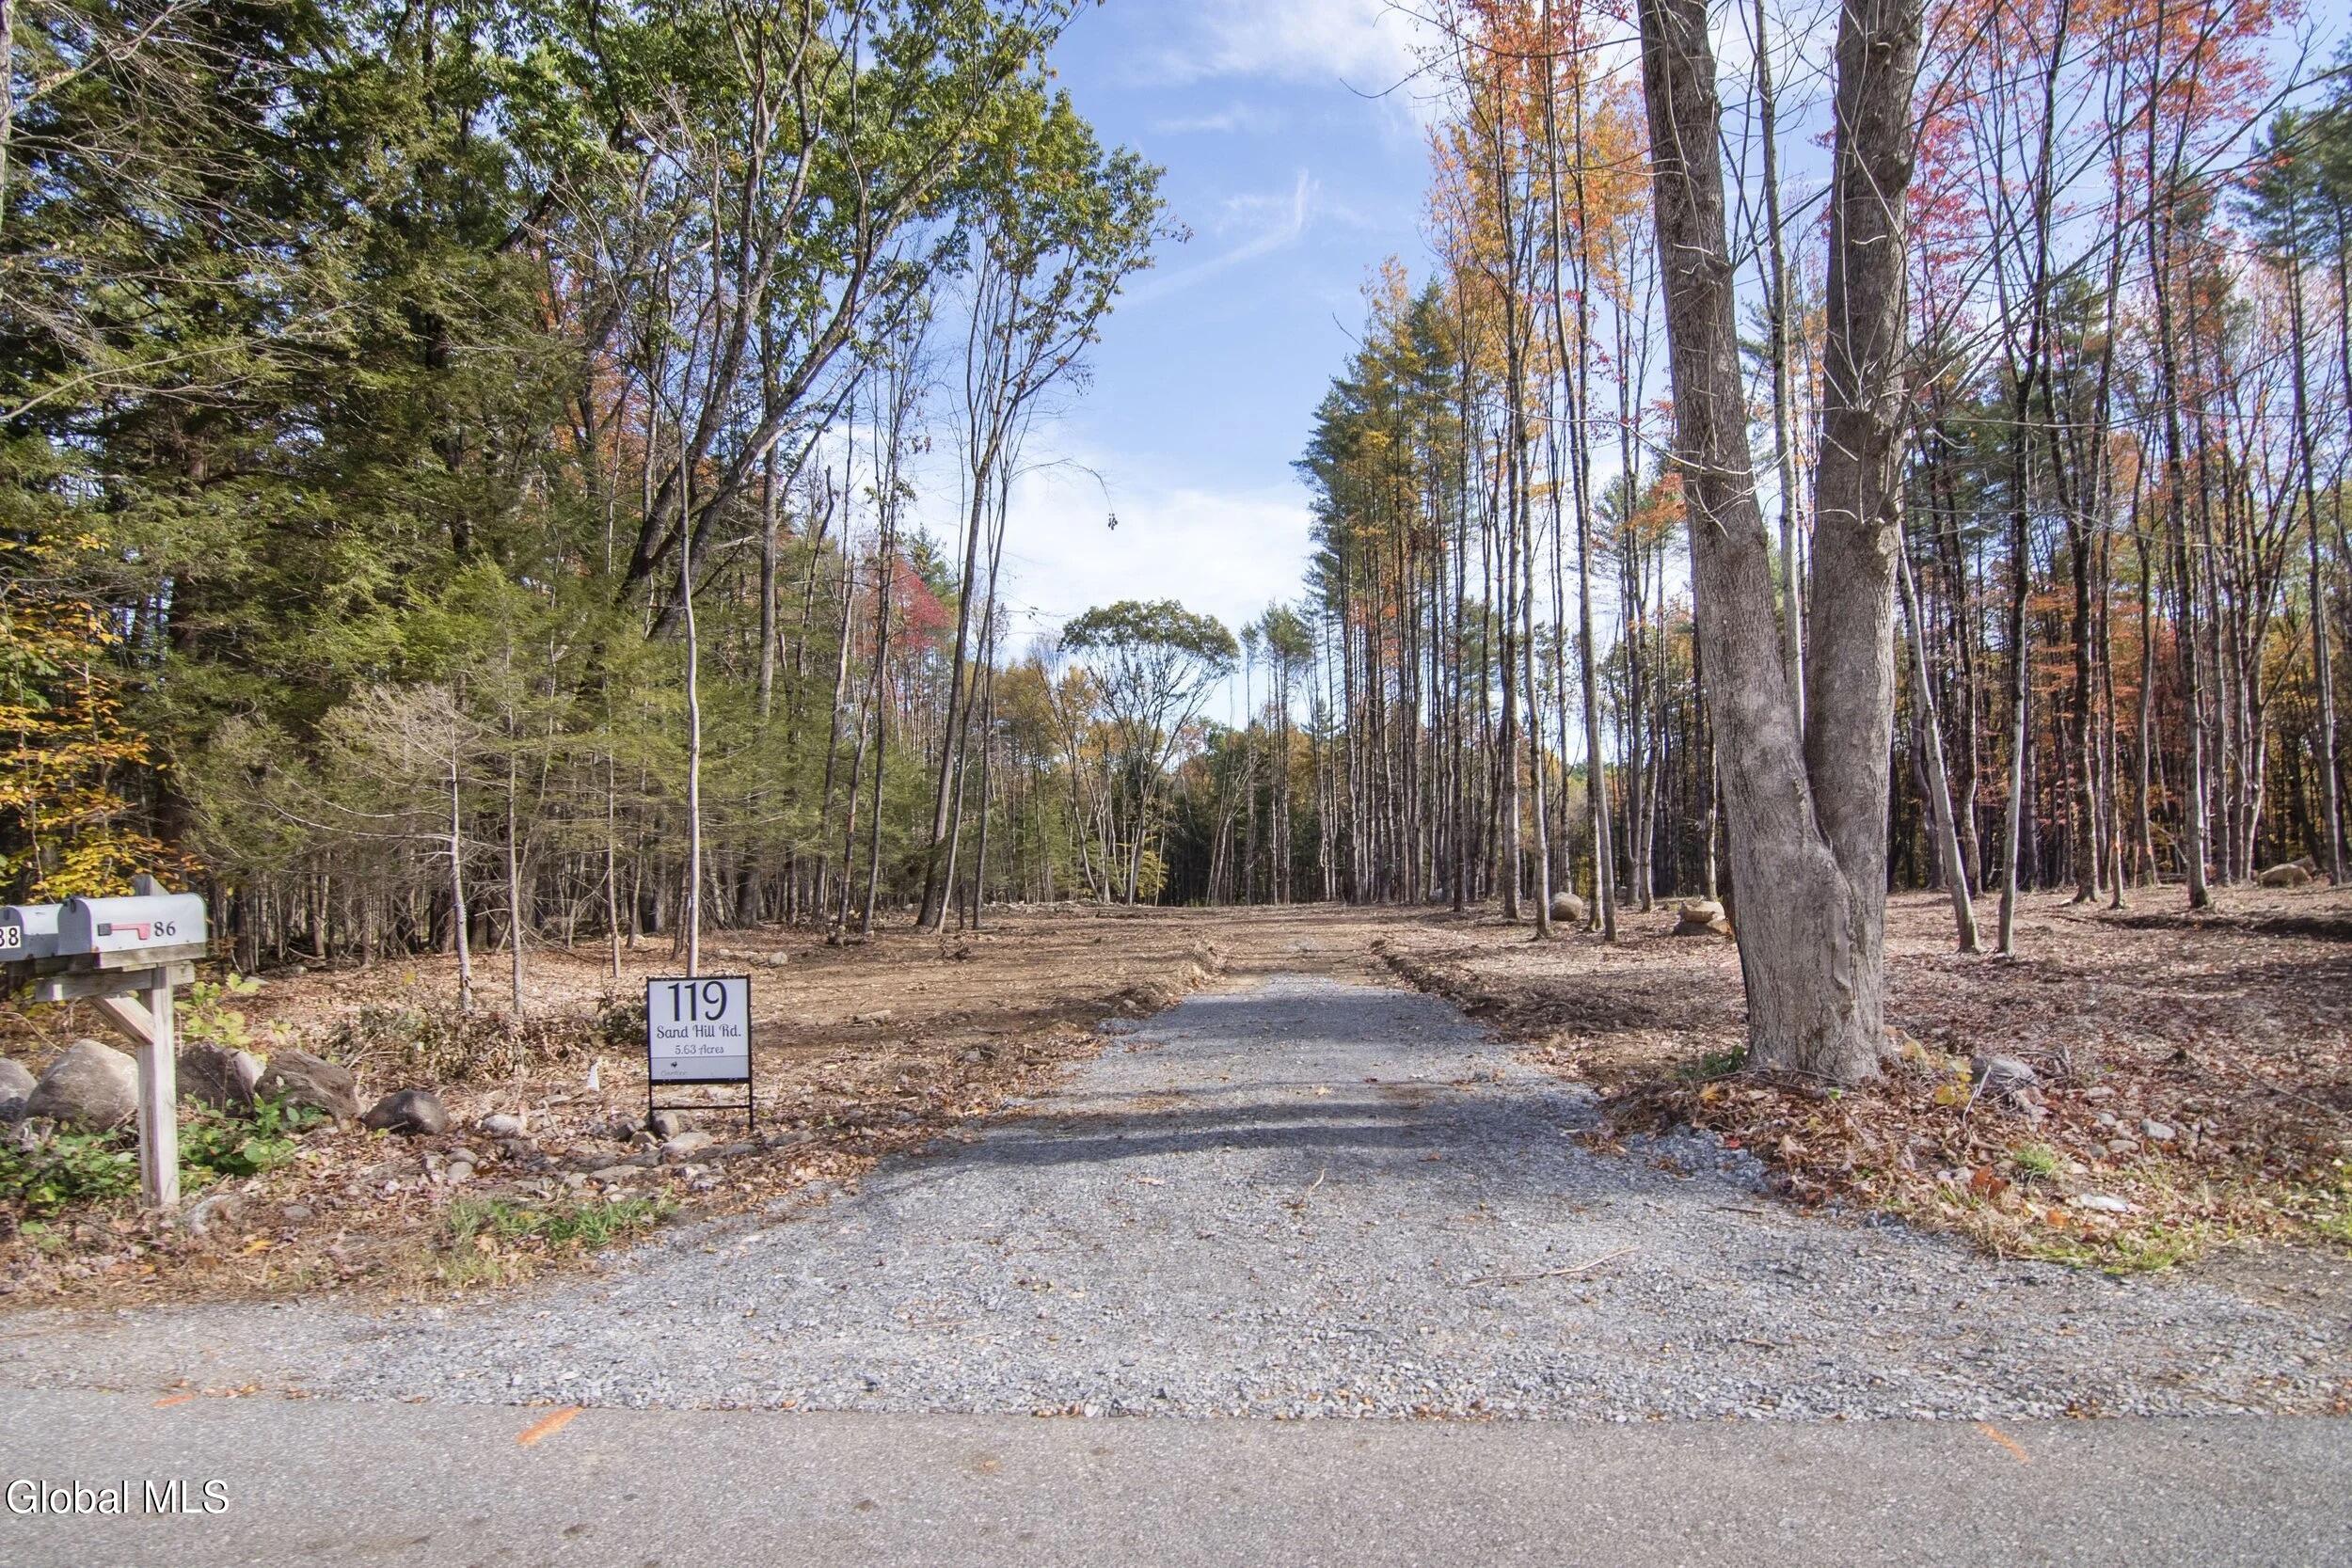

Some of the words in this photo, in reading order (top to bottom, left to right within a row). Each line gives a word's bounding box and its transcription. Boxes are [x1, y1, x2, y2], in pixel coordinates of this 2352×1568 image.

[154, 921, 177, 937] 86
[667, 981, 727, 1022] 119
[657, 1025, 689, 1038] Sand
[692, 1024, 715, 1037] Hill
[719, 1023, 741, 1037] Rd.
[675, 1044, 696, 1054] 5.63
[698, 1044, 724, 1054] Acres
